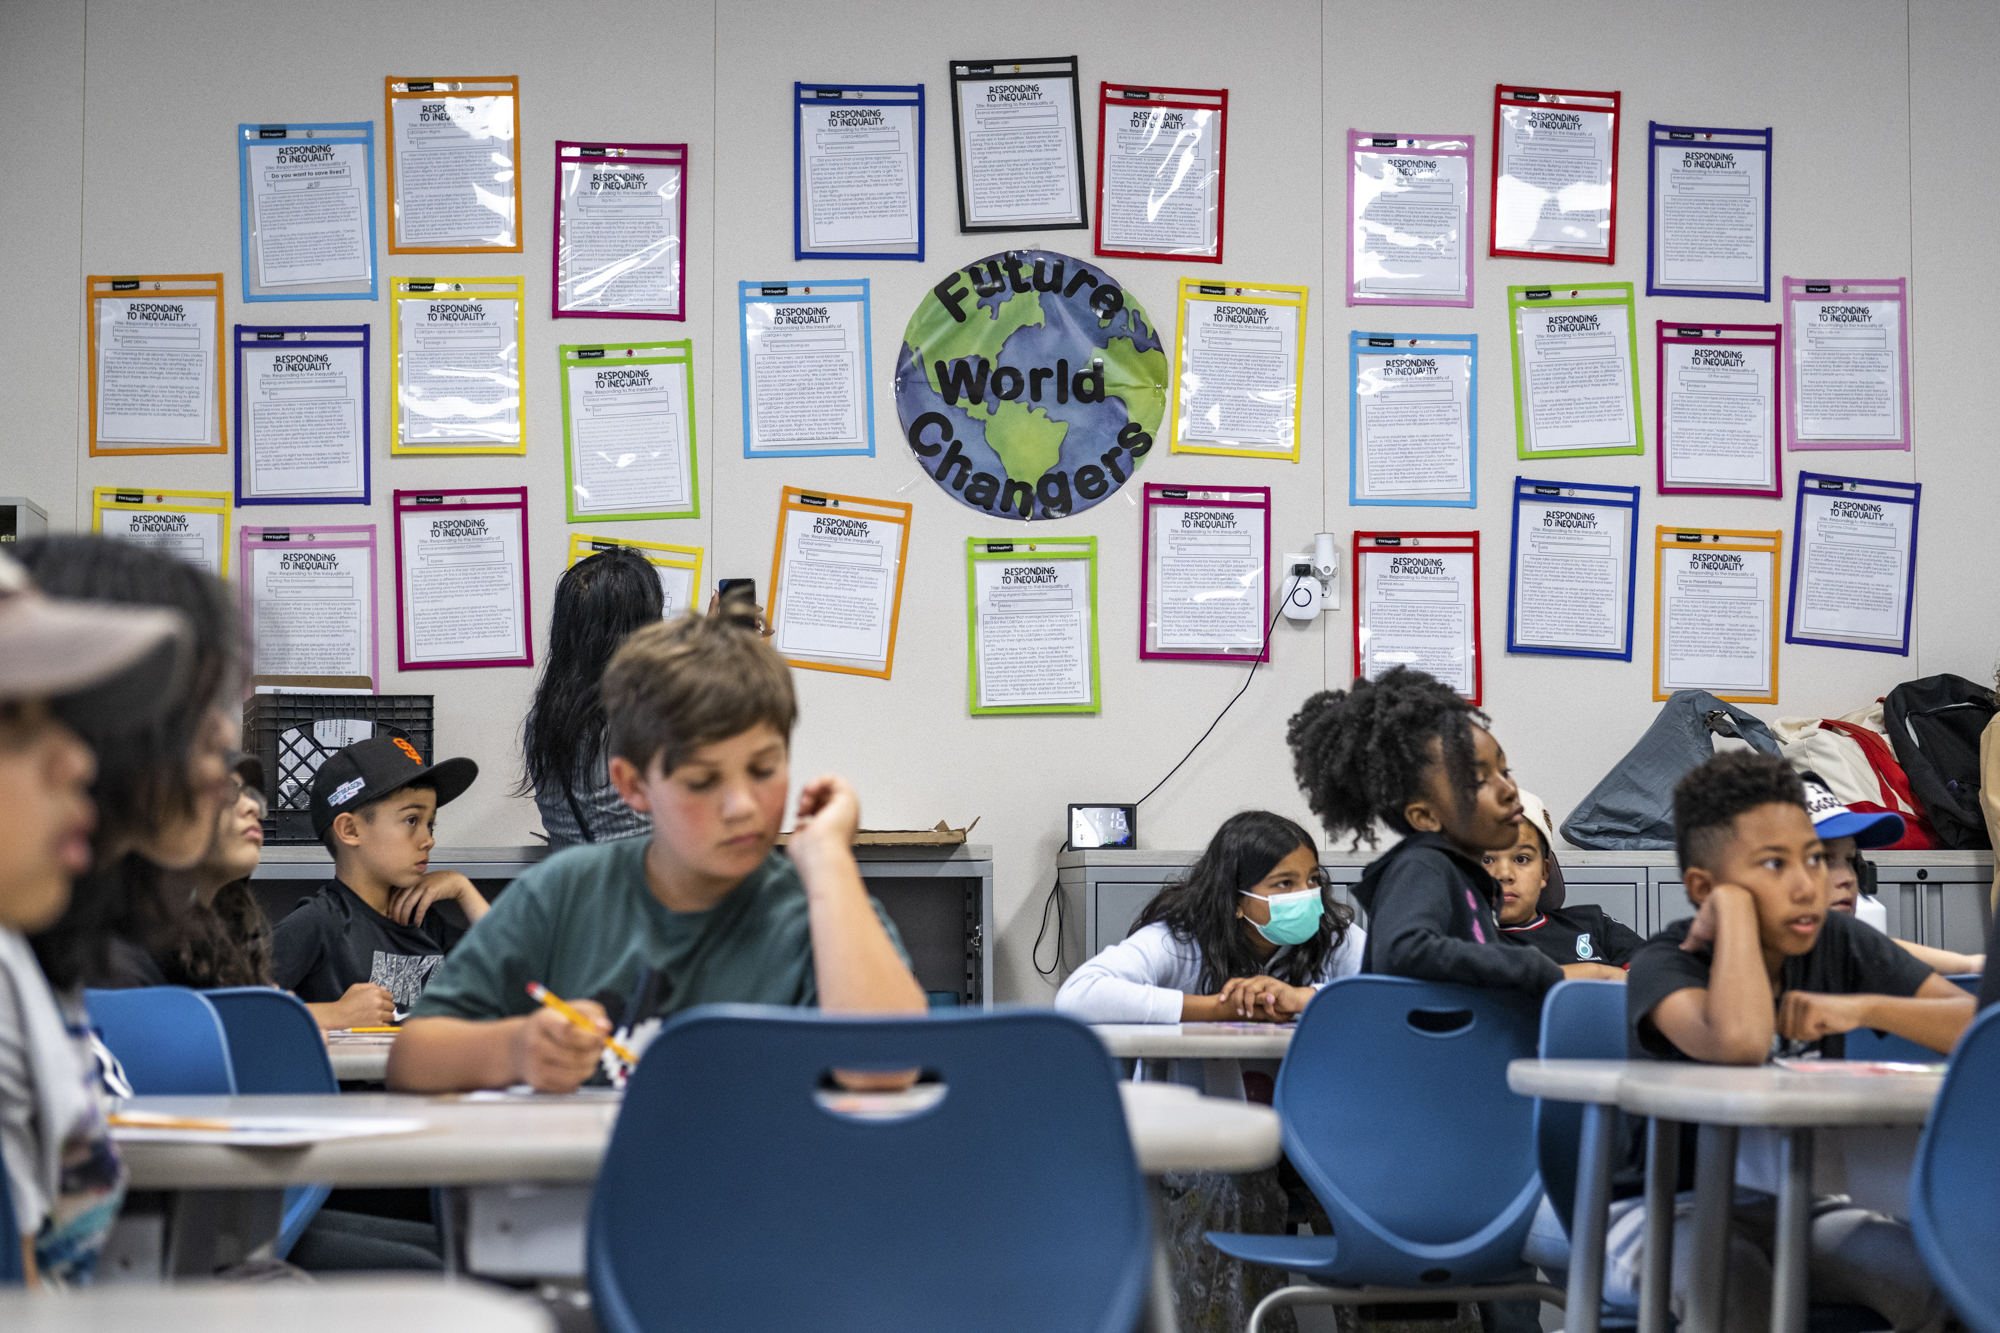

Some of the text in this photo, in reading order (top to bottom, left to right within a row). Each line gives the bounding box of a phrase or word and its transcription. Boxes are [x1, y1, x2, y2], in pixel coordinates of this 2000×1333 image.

[987, 94, 996, 102] TO
[420, 113, 430, 121] TO
[828, 119, 837, 127] TO
[276, 156, 286, 164] TO
[1683, 160, 1692, 168] TO
[590, 182, 600, 190] TO
[934, 251, 1124, 323] Future
[127, 312, 137, 320] TO
[427, 313, 437, 321] TO
[1214, 314, 1223, 322] TO
[1819, 314, 1828, 322] TO
[1692, 357, 1701, 365] TO
[273, 364, 283, 372] TO
[595, 380, 605, 388] TO
[935, 358, 1105, 405] World
[909, 412, 1153, 520] Changers
[130, 524, 139, 532] TO
[1181, 520, 1191, 528] TO
[430, 529, 440, 537] TO
[813, 525, 822, 533] TO
[280, 562, 290, 570] TO
[1690, 561, 1699, 569] TO
[1002, 576, 1011, 584] TO
